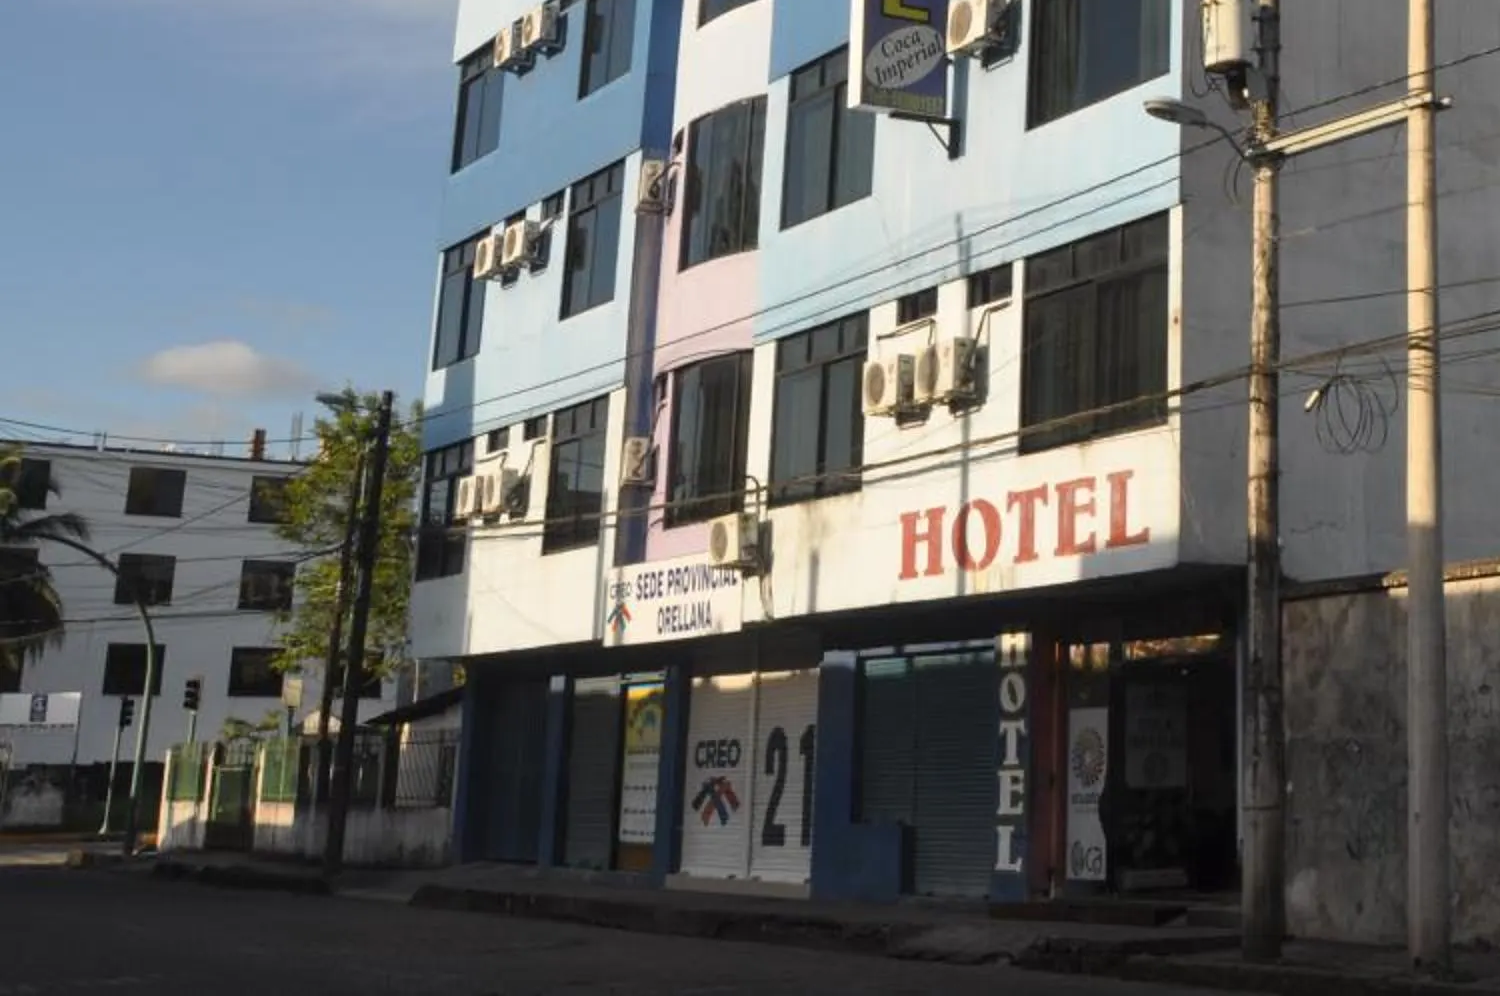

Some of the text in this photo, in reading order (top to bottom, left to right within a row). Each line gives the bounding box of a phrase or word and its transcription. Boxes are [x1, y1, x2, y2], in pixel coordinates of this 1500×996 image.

[875, 33, 942, 85] Imperial
[881, 30, 921, 58] Coca
[897, 468, 1151, 582] HOTEL
[635, 562, 738, 601] SEDE PROVINCIAL
[657, 600, 713, 636] ORELLANA
[695, 738, 741, 769] CREO
[993, 632, 1033, 873] HOTEL
[761, 723, 817, 847] 21
